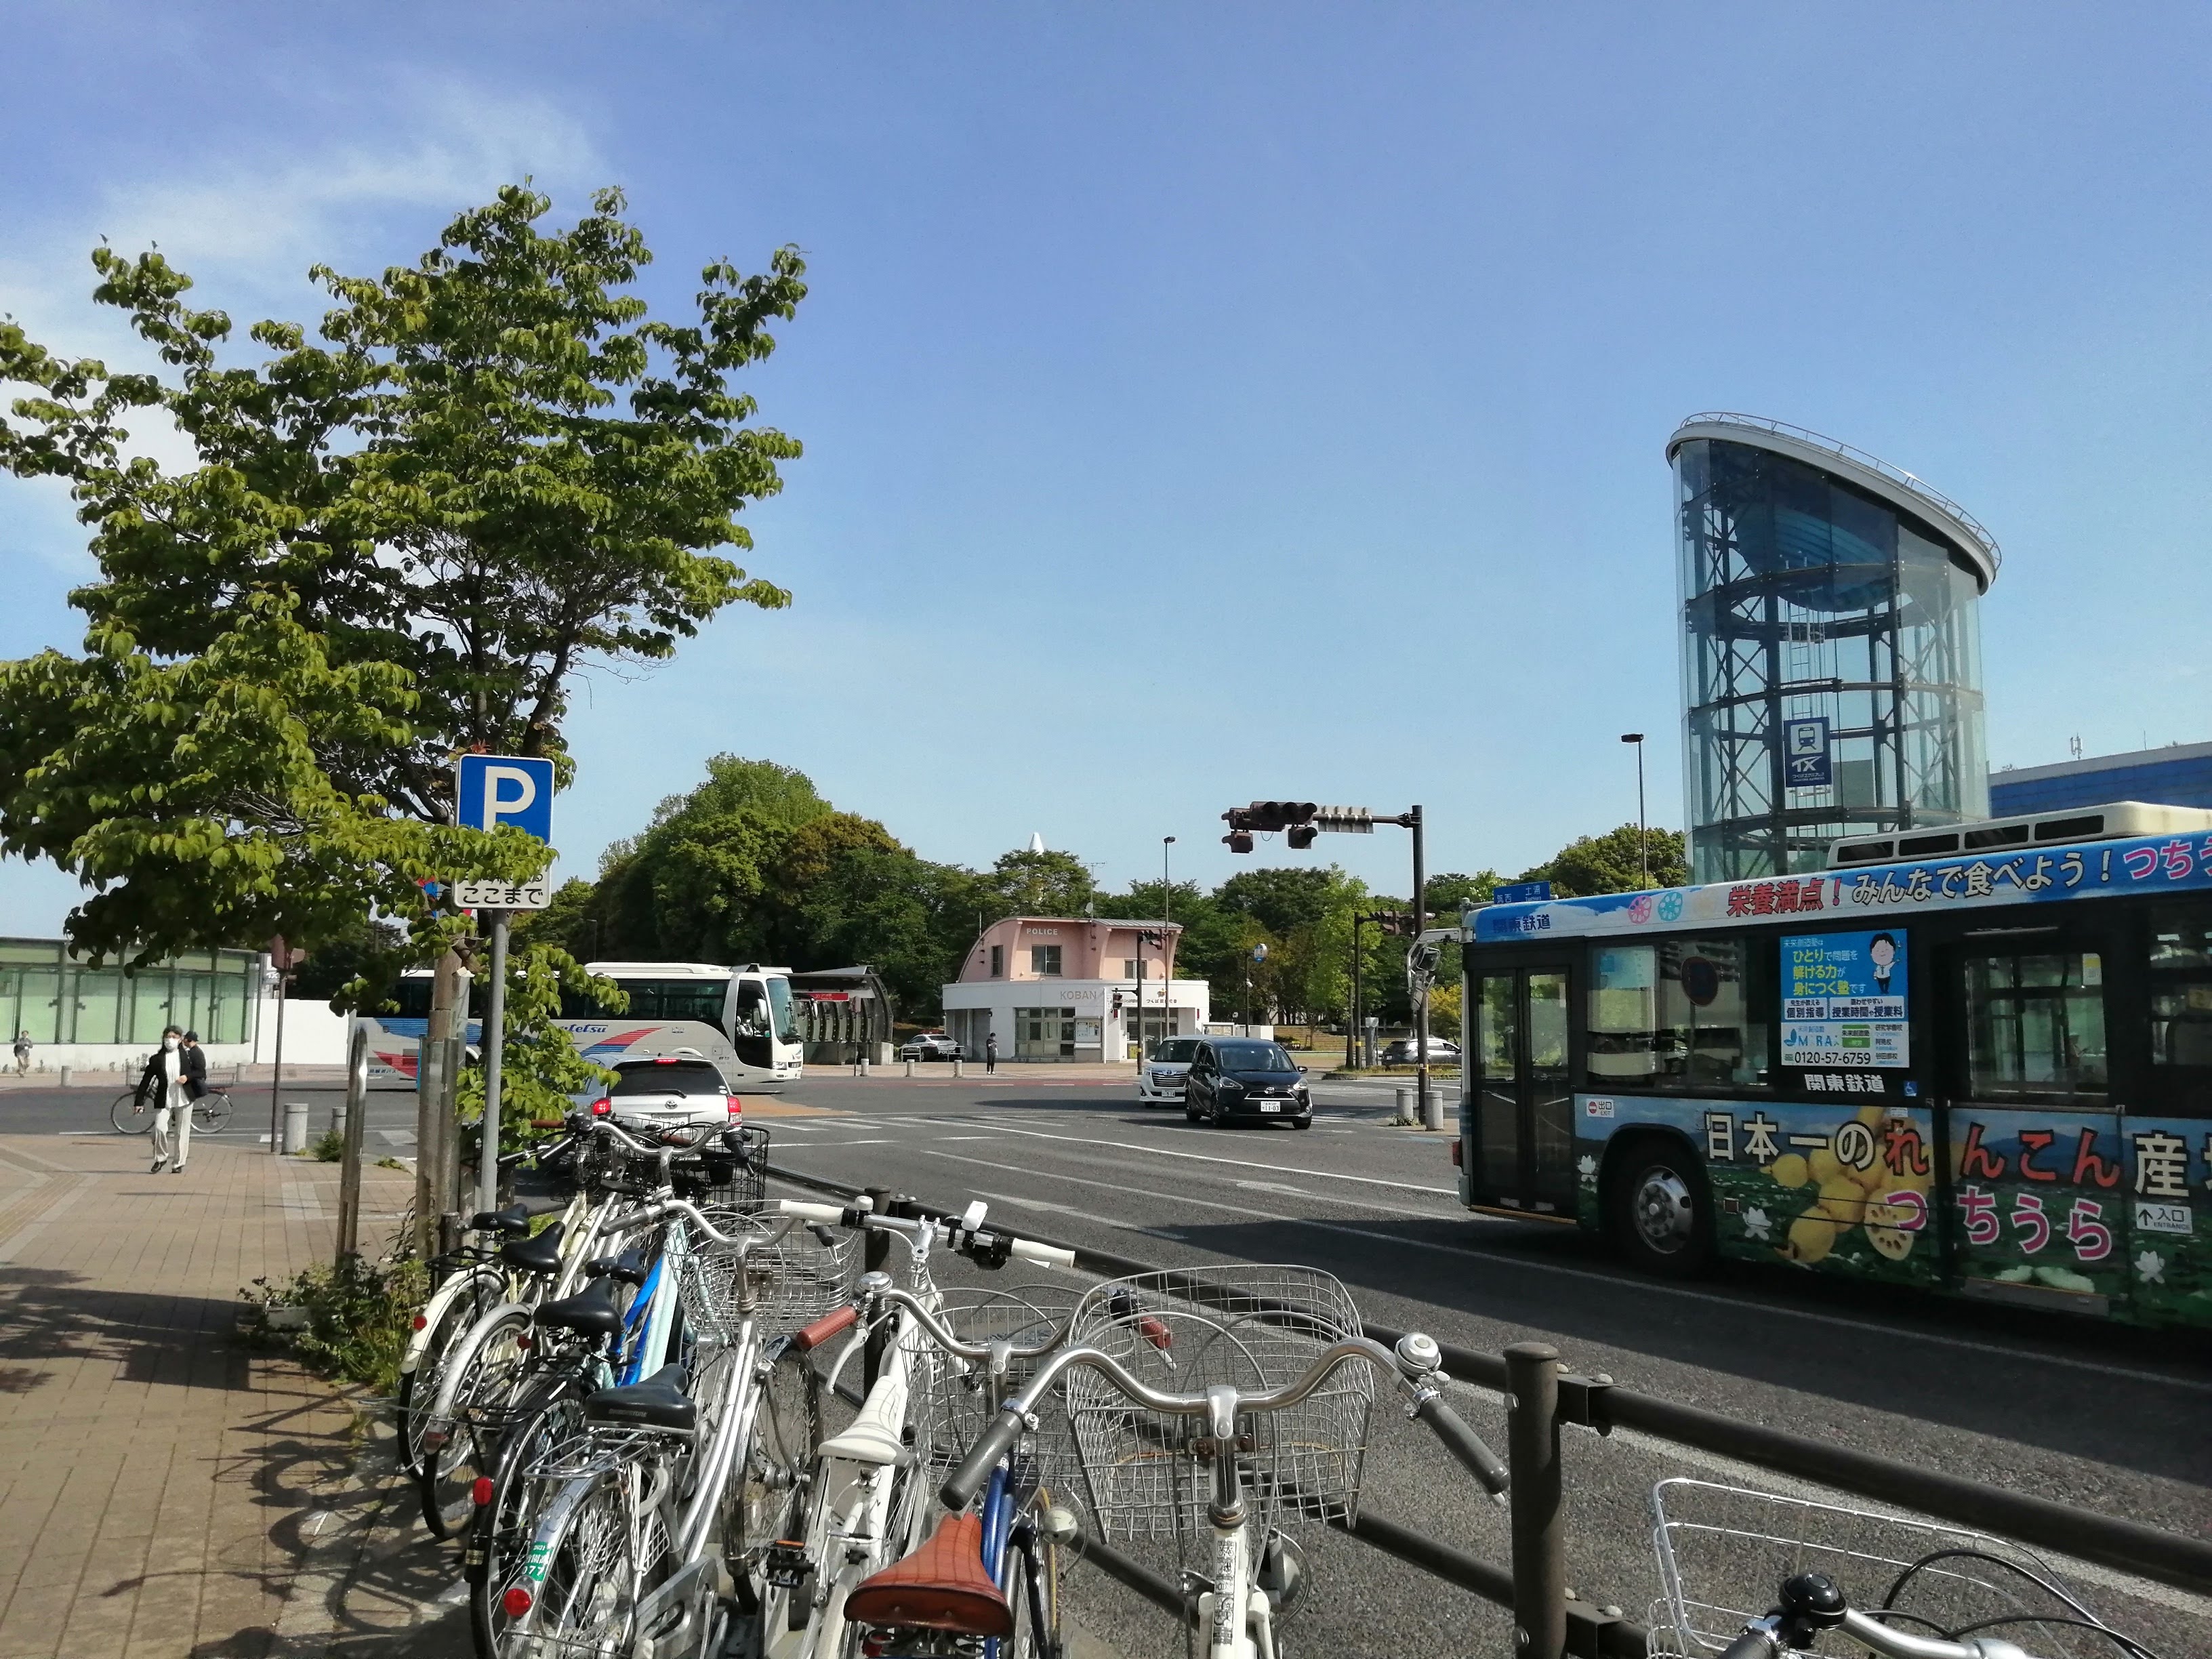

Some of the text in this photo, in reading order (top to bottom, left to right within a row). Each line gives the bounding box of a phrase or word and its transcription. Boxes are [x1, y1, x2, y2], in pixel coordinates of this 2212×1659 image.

[1792, 756, 1822, 773] TX
[484, 766, 536, 833] P
[1851, 850, 2111, 905] みんなで食べよう！
[463, 887, 544, 905] ここまで
[1525, 885, 1540, 896] 土浦
[1793, 949, 1858, 963] ひとりで問題を
[1793, 964, 1847, 980] 解ける力が
[1060, 991, 1097, 1000] KOBAN
[1793, 981, 1866, 996] 身につく塾です
[1786, 1007, 1825, 1019] 個別指導
[1832, 1005, 1903, 1018] 授業時間や授業料
[1795, 1052, 1871, 1065] 0120-57-6759
[1804, 1073, 1885, 1093] 関東鉄道
[1599, 1101, 1612, 1110] 出口
[2158, 1208, 2184, 1222] 入口
[1884, 1185, 2113, 1261] つちうら
[2154, 1221, 2190, 1231] ENTRANCE
